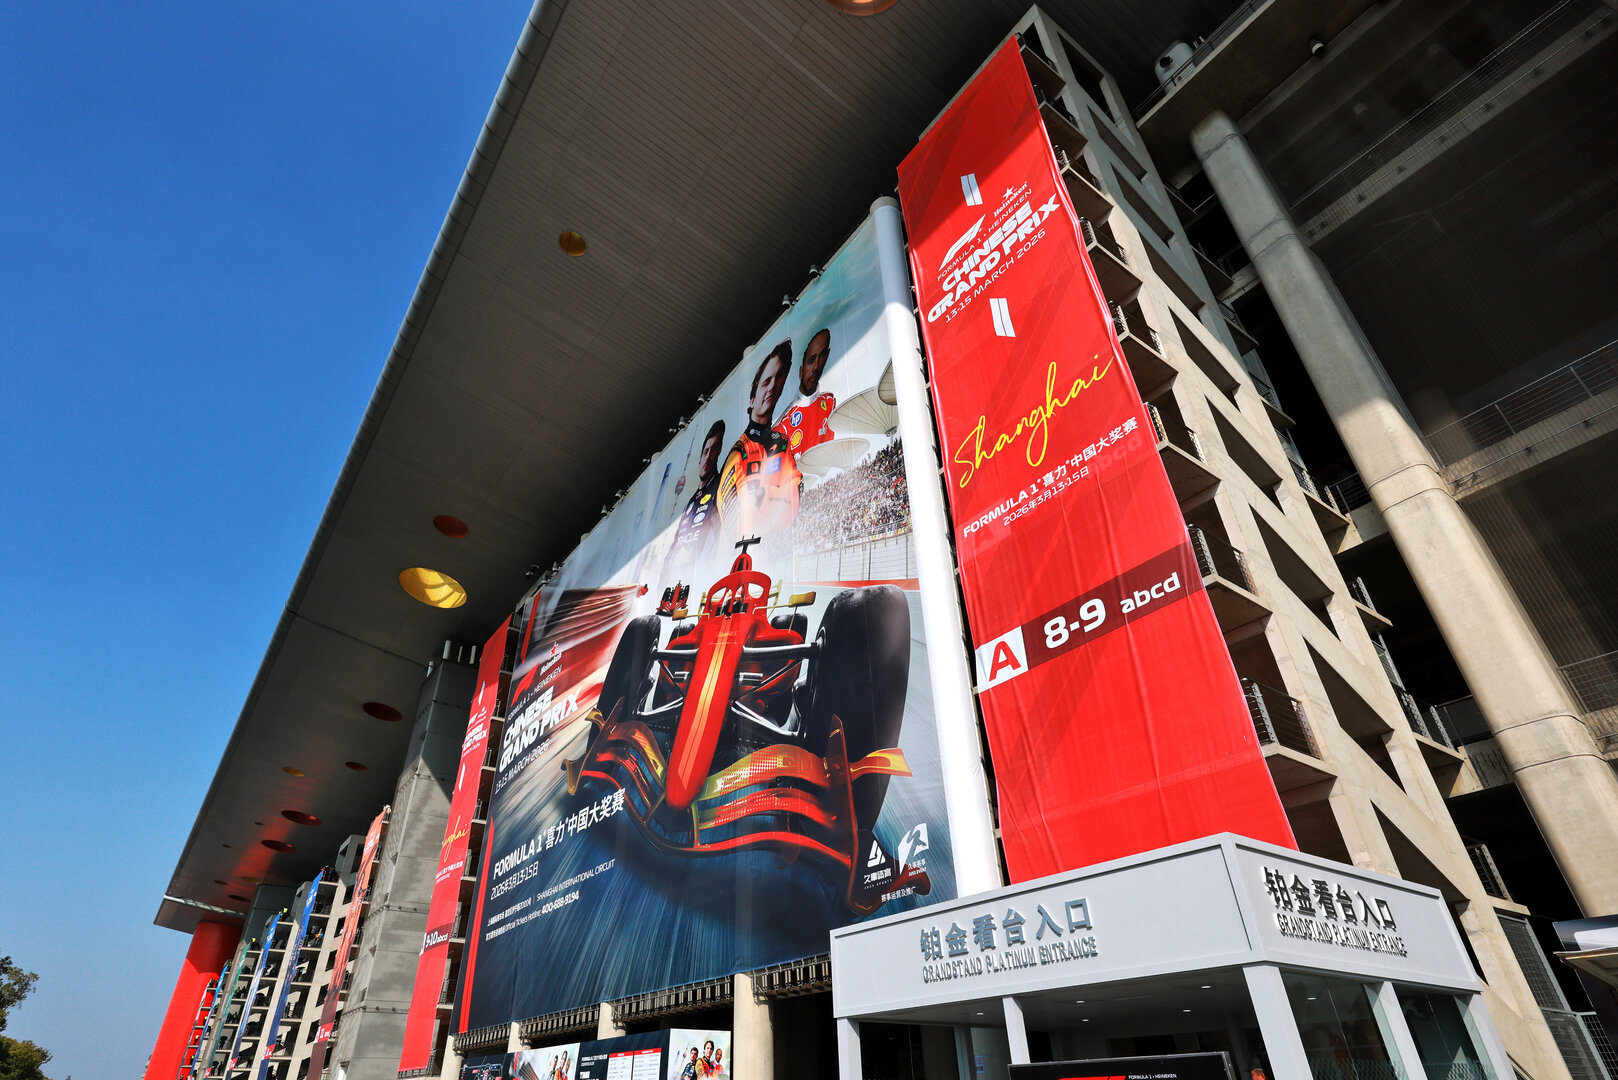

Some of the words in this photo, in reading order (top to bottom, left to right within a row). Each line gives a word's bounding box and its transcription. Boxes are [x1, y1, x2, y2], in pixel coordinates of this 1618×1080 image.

[993, 180, 1028, 217] Heineken
[927, 250, 1001, 323] GRAND
[1002, 193, 1061, 255] PRIX
[937, 243, 975, 282] FORMULA
[988, 188, 1033, 232] HEINEKEN
[942, 201, 1032, 292] CHINESE
[945, 296, 972, 324] 13-15
[973, 259, 1016, 296] MARCH
[1016, 228, 1046, 260] 2026
[954, 354, 1115, 488] Shanghai
[963, 490, 1030, 539] FORMULA
[1003, 465, 1090, 526] 2026年3月13-15日
[988, 640, 1022, 682] A
[1043, 598, 1107, 649] 8-9
[1119, 571, 1182, 614] abcd
[499, 720, 541, 773] GRAND
[539, 686, 582, 736] PRIX
[503, 685, 555, 749] CHINESE
[508, 752, 531, 782] MARCH
[530, 738, 550, 762] 2026
[493, 839, 535, 880] FORMULA
[557, 867, 595, 893] INTERNATIONAL
[594, 858, 616, 876] CIRCUIT
[919, 898, 1094, 962] 铂金看台入口
[1263, 866, 1397, 932] 铂金看台入口
[922, 956, 984, 984] GRANDSTAND
[985, 947, 1038, 973] PLATINUM
[1039, 936, 1099, 965] ENTRANCE
[1275, 912, 1334, 945] GRANDSTAND
[1331, 924, 1372, 952] PLATINUM
[1370, 932, 1408, 958] ENTRANCE
